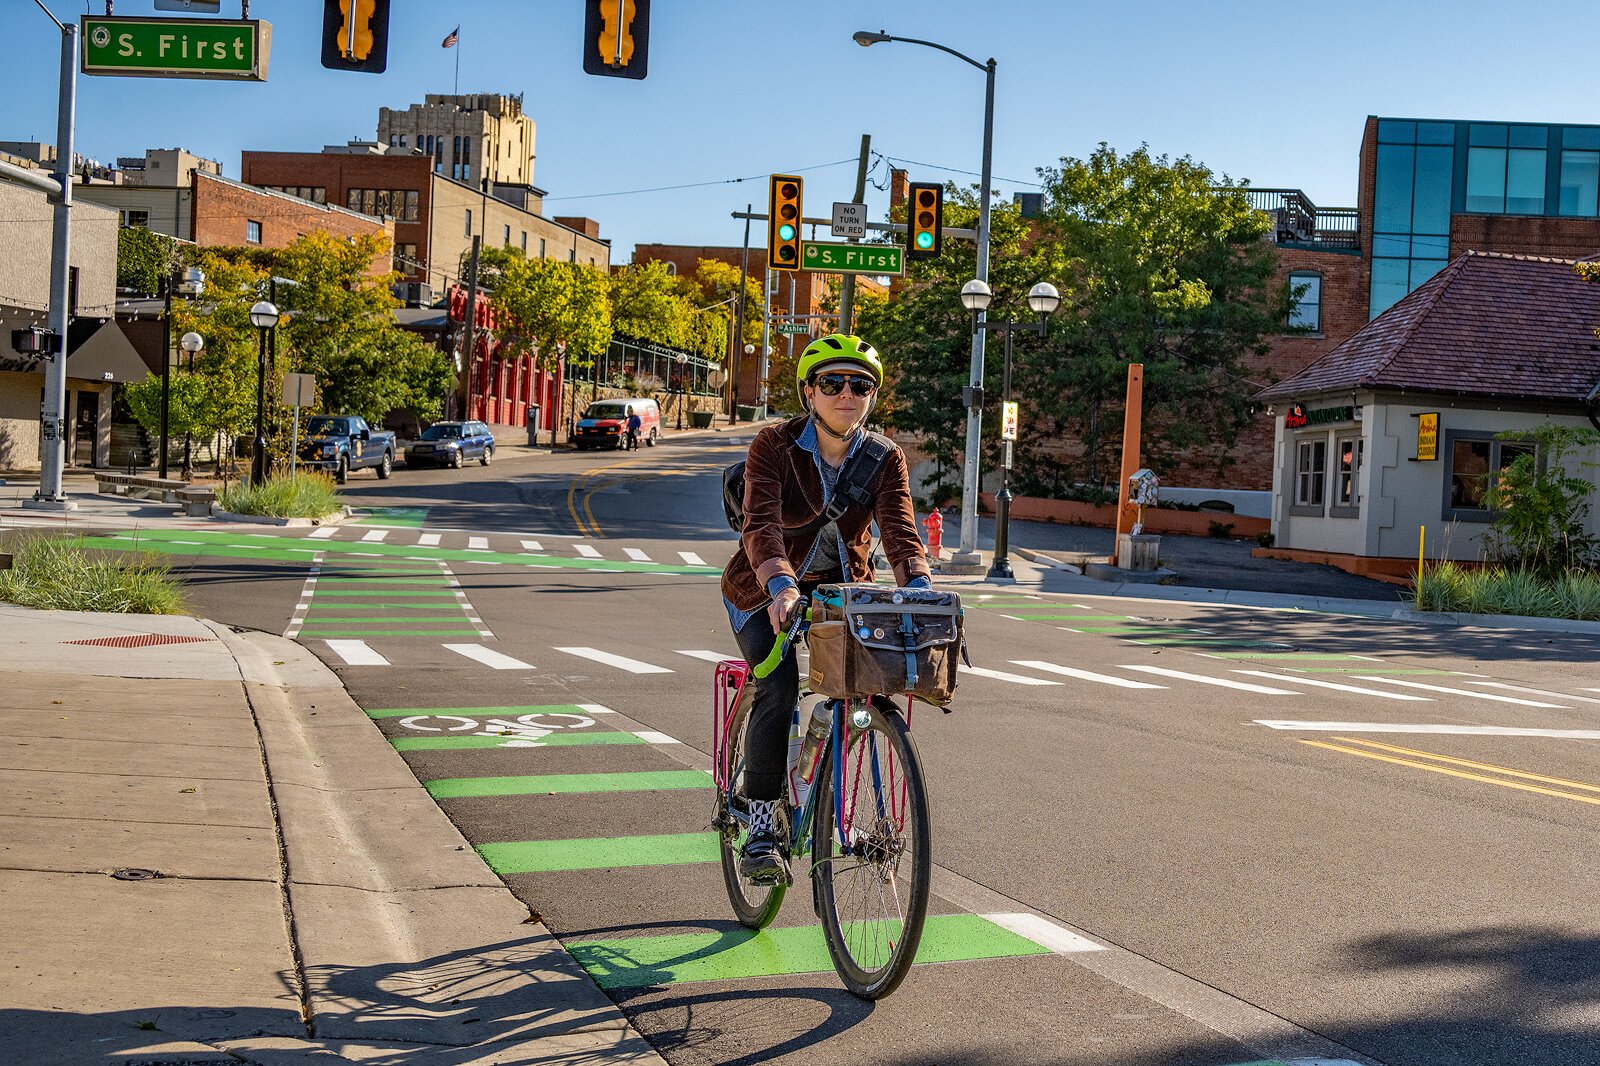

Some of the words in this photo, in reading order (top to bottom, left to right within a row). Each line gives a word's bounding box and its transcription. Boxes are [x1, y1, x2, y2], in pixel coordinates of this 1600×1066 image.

[118, 33, 142, 57] S.
[159, 35, 244, 60] First
[843, 207, 856, 215] NO
[840, 216, 860, 225] TURN
[848, 226, 863, 234] RED
[822, 250, 837, 264] S.
[846, 251, 897, 267] First
